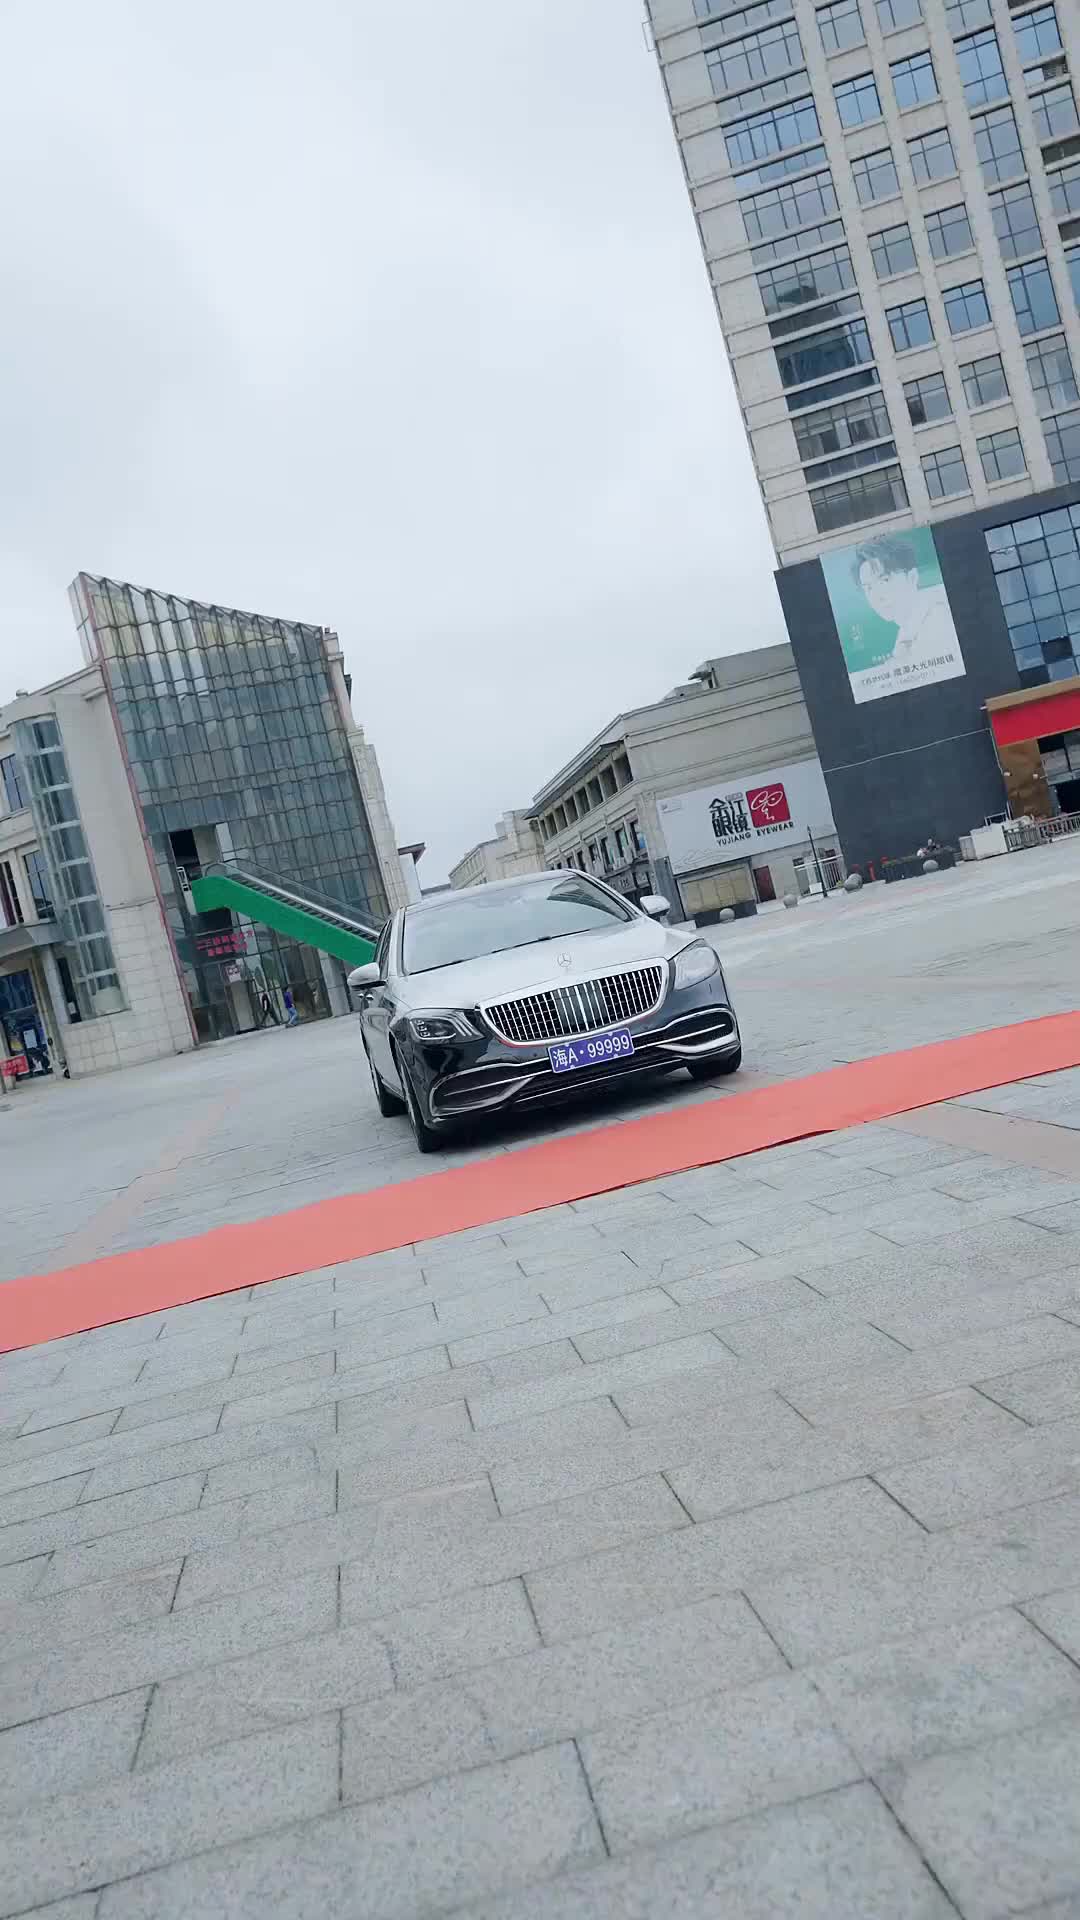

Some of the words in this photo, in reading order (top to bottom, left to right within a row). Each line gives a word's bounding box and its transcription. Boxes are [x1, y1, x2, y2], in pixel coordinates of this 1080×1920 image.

[709, 798, 748, 819] 余江
[711, 813, 751, 838] 眼镜
[717, 832, 752, 846] YUJIANG
[756, 821, 794, 837] EYEWEAR
